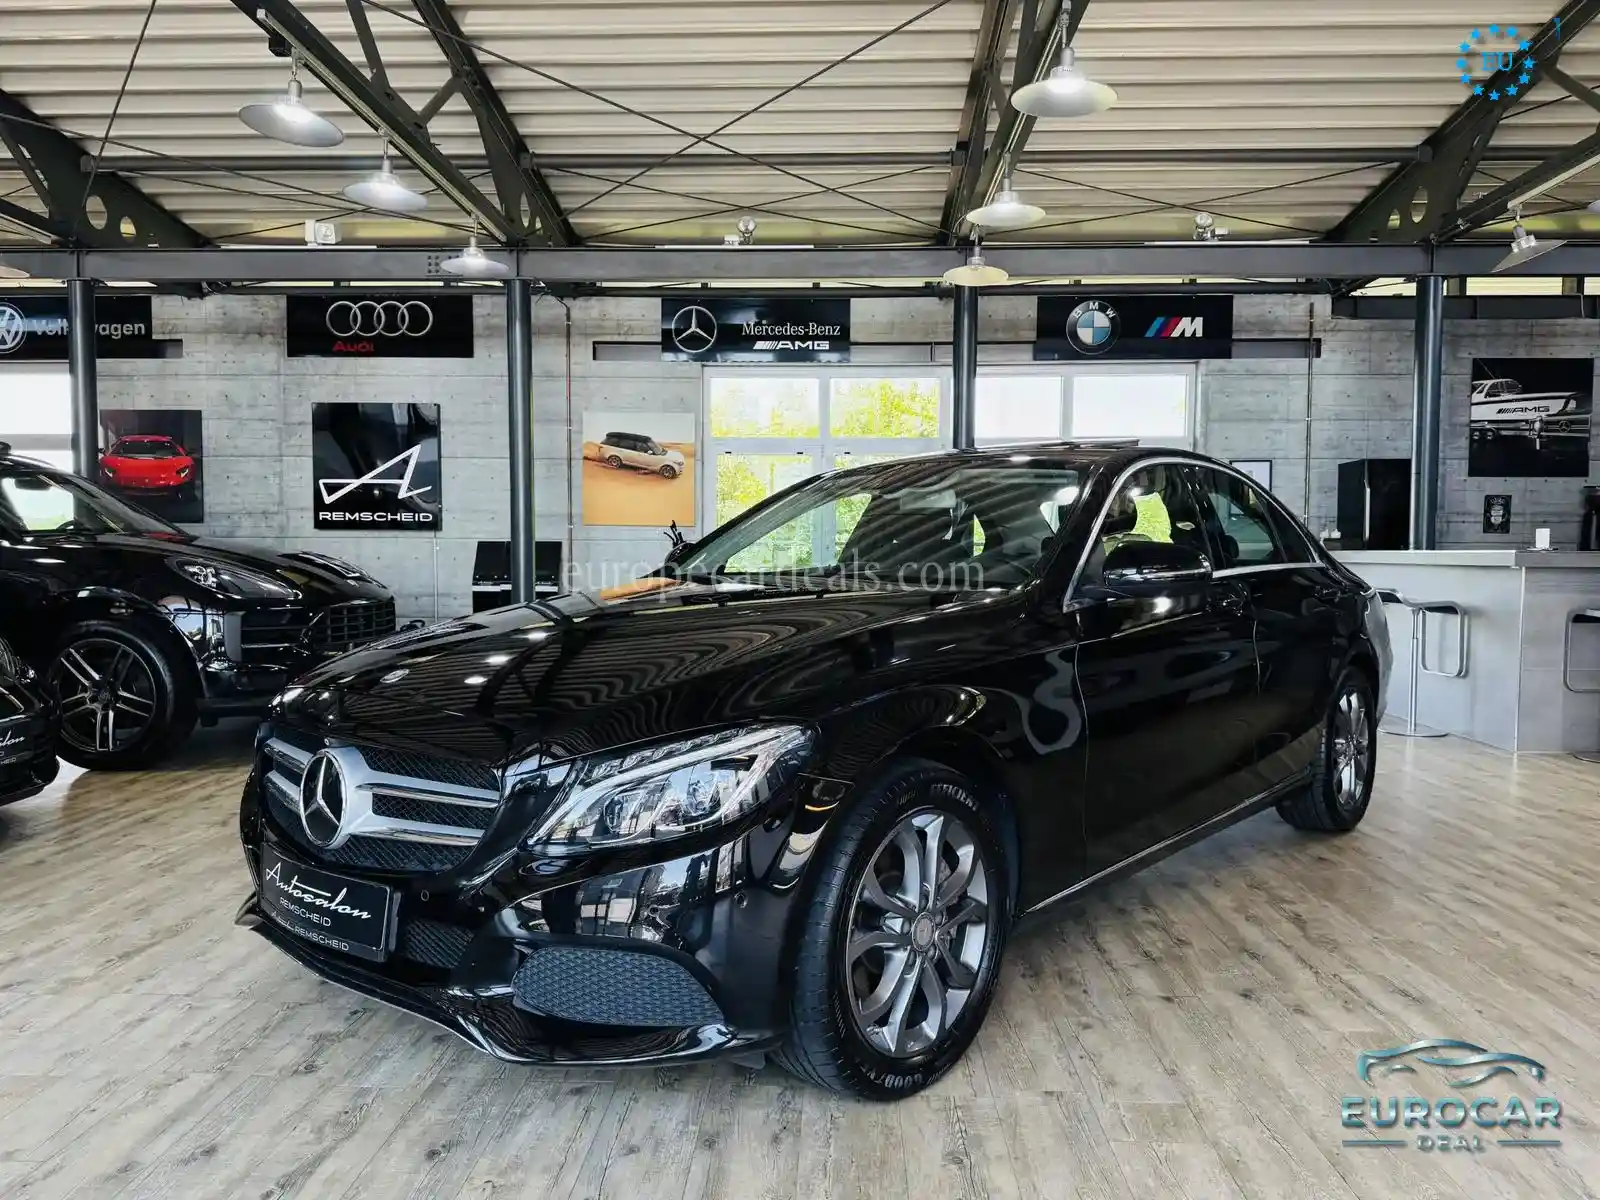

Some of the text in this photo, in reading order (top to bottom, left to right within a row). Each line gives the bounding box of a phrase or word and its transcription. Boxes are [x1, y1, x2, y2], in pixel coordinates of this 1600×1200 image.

[1073, 301, 1116, 319] BMW
[34, 317, 146, 340] Volkagen
[741, 321, 841, 337] Mercedes-Benz
[332, 341, 375, 353] Audi
[775, 340, 830, 350] AMG
[1512, 404, 1551, 413] AMG
[318, 511, 433, 523] REMSCHEID
[265, 861, 372, 919] Autosalon
[279, 896, 332, 927] REMSCHEID
[294, 926, 350, 951] REMSCHEID
